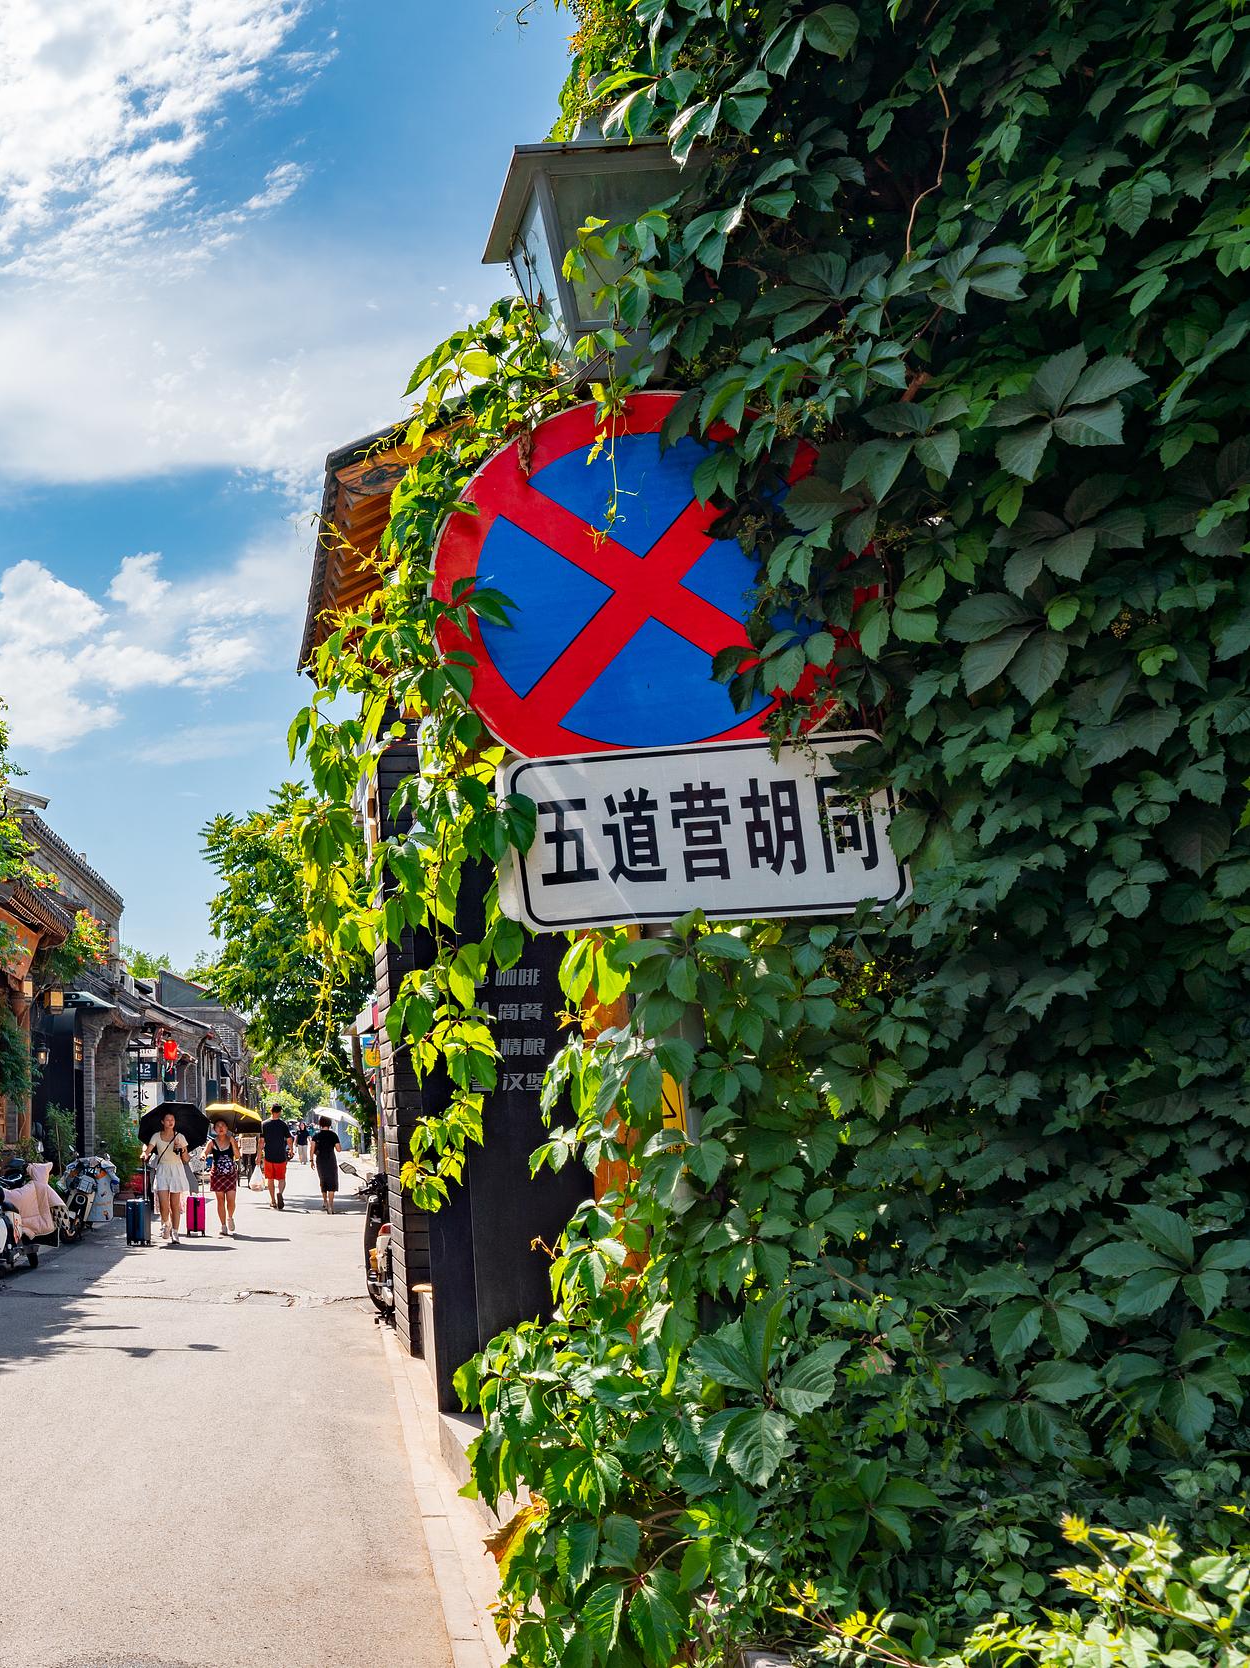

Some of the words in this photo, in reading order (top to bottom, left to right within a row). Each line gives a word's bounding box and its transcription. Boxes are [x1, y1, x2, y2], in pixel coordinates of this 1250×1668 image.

[537, 778, 880, 887] 五道营胡同
[495, 968, 540, 986] 咖啡
[498, 1002, 543, 1021] 简餐
[500, 1038, 546, 1056] 精酿
[502, 1072, 546, 1091] 汉堡
